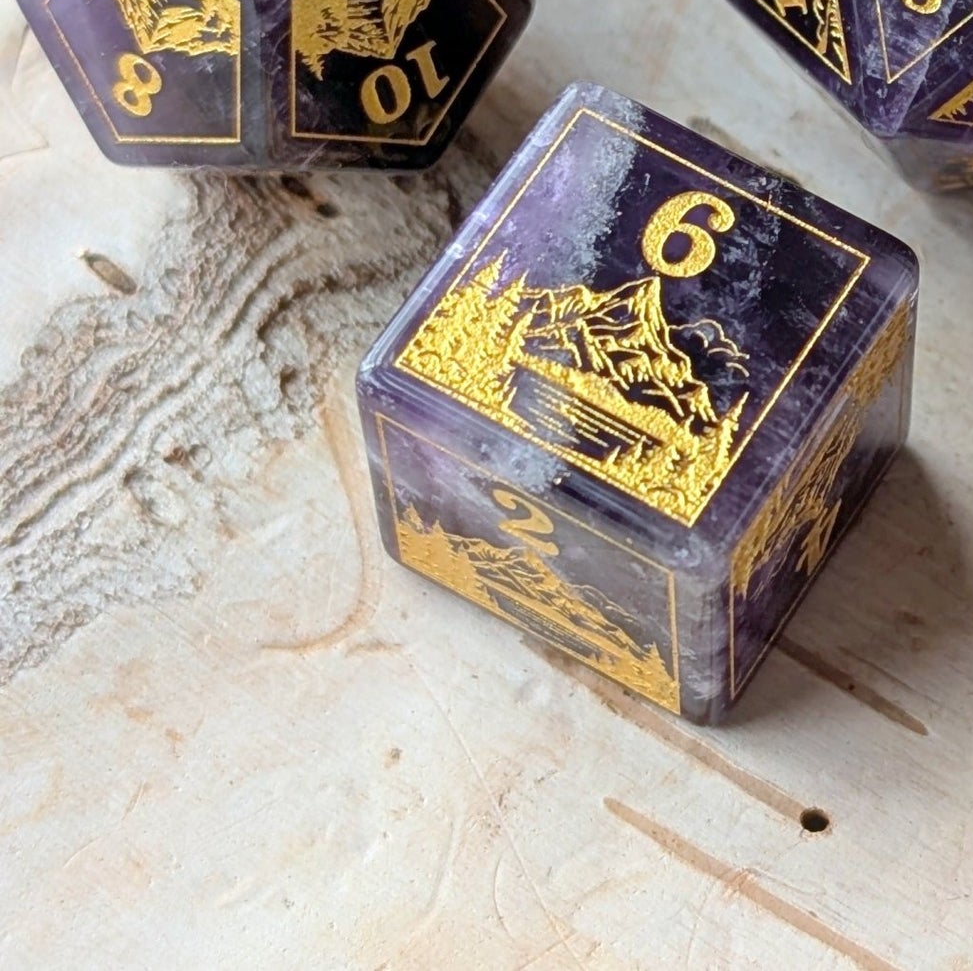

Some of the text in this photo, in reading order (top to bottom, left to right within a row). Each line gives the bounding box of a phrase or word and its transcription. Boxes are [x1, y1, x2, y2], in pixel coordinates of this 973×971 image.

[113, 53, 163, 117] 8
[360, 40, 451, 125] 10
[641, 191, 736, 278] 6
[492, 489, 560, 557] 2
